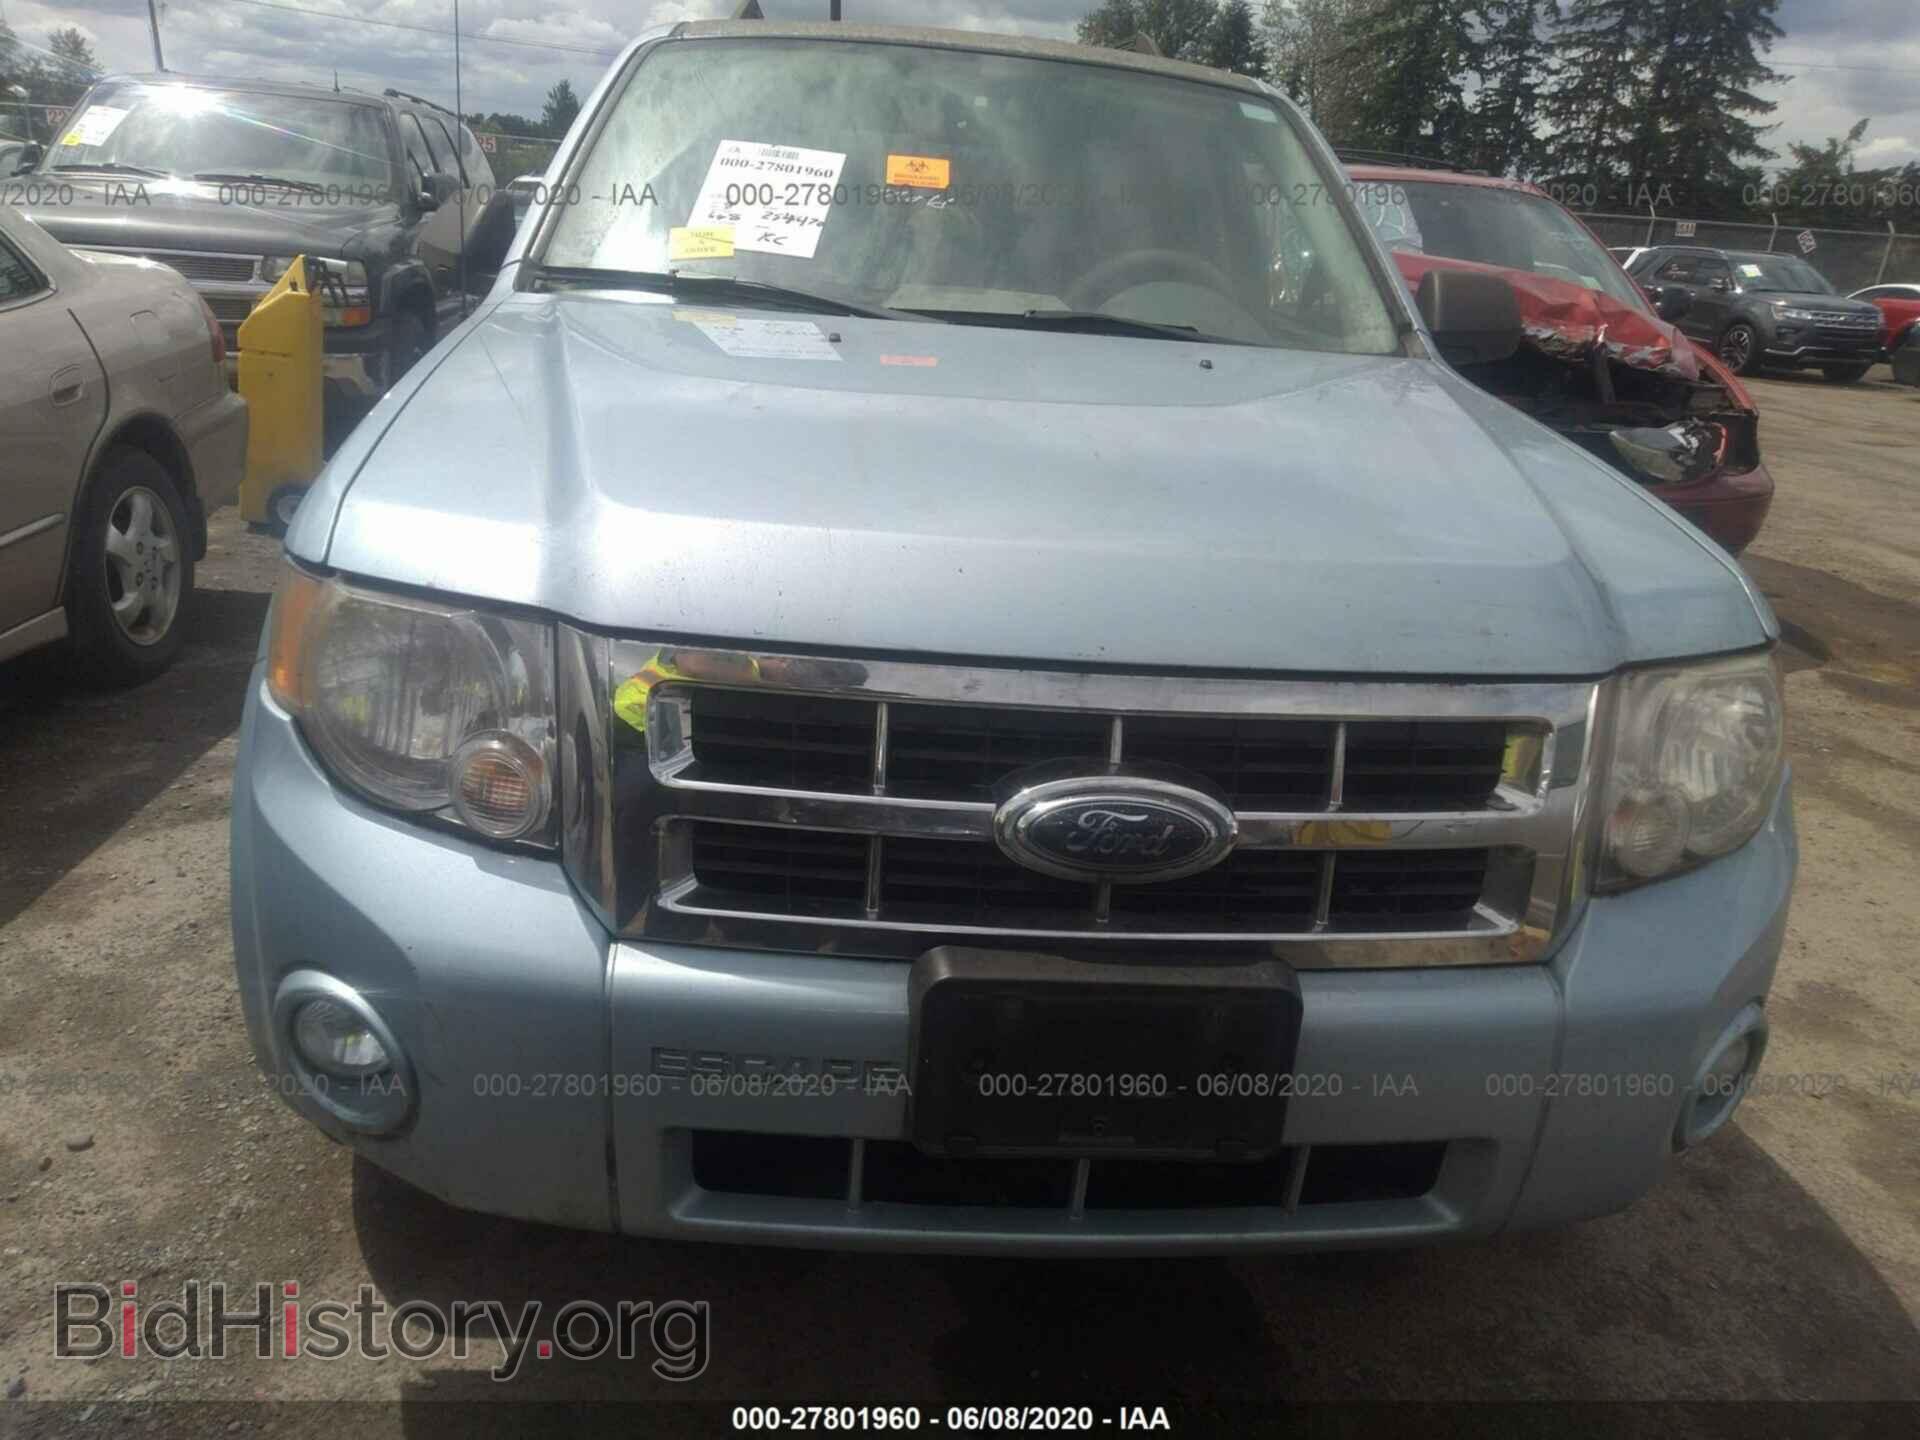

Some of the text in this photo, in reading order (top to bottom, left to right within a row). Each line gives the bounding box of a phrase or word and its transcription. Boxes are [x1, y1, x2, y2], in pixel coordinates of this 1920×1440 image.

[719, 157, 834, 179] 000-27801960
[1065, 808, 1177, 855] Ford
[650, 1046, 903, 1091] ESCAPE
